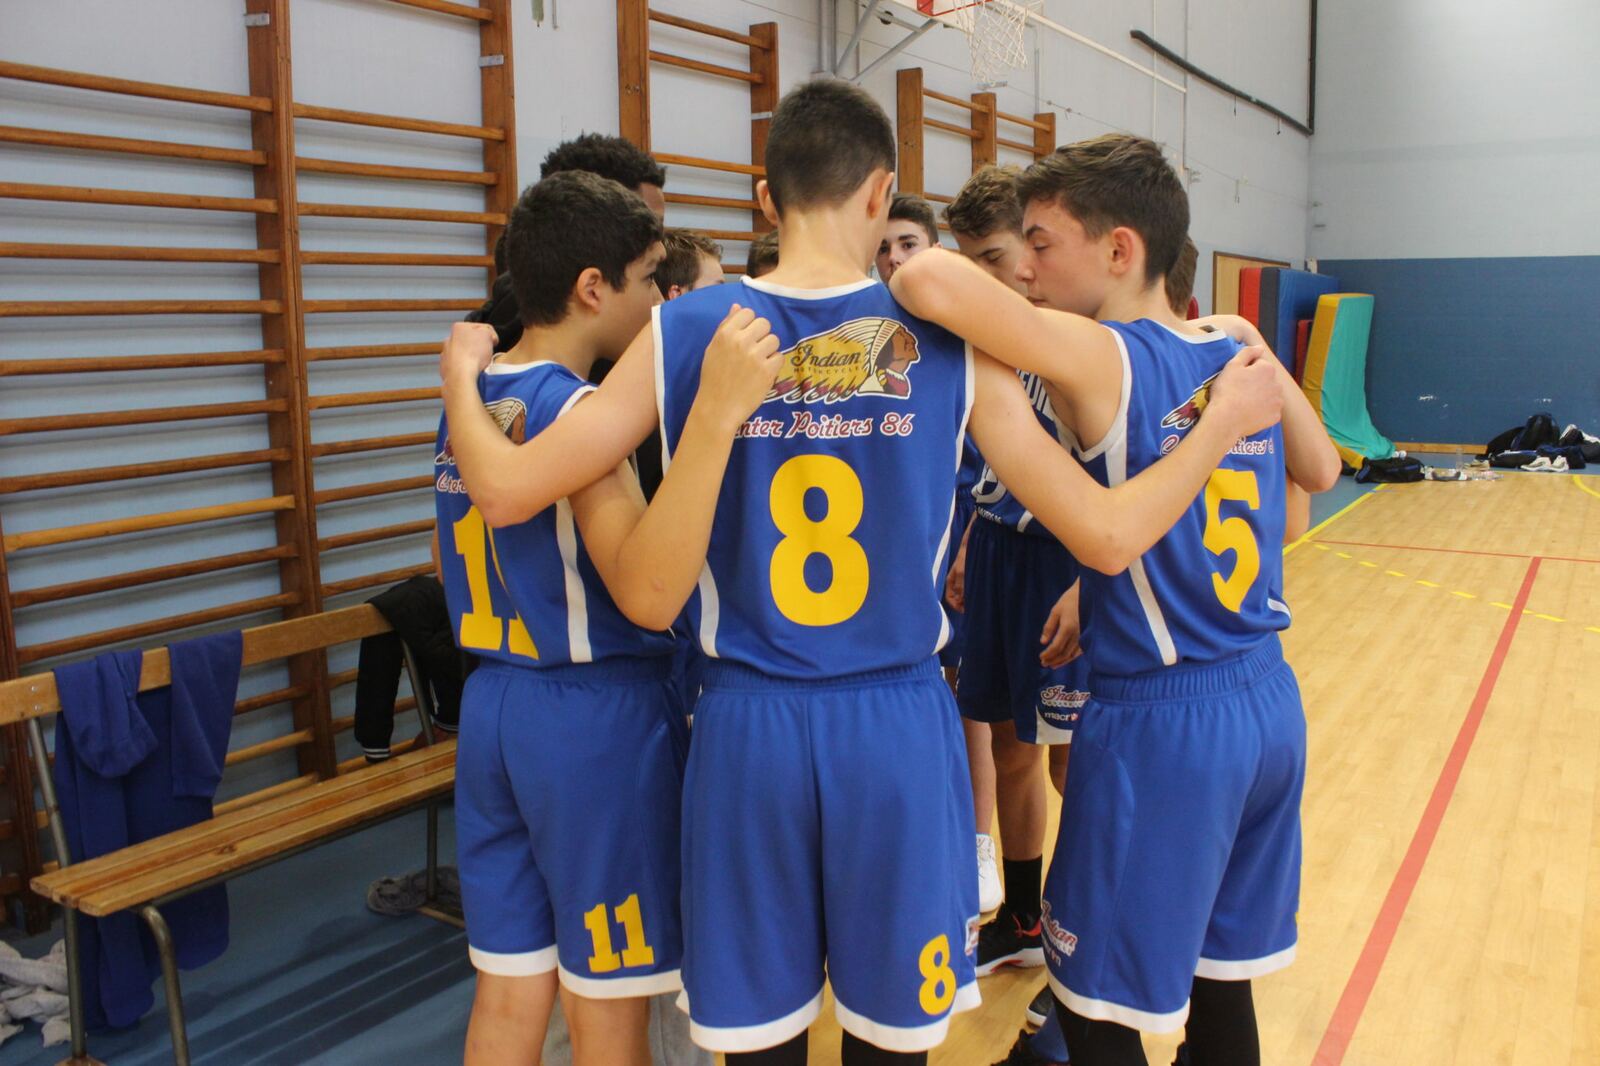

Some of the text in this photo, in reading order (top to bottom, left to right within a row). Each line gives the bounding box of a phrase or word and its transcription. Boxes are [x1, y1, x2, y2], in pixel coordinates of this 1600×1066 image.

[790, 344, 861, 367] Indian
[735, 411, 915, 438] nter Poitiers 86
[1227, 435, 1268, 455] tiers
[769, 454, 869, 626] 8
[1203, 468, 1260, 613] 5
[584, 893, 655, 973] 11
[918, 934, 957, 1016] 8
